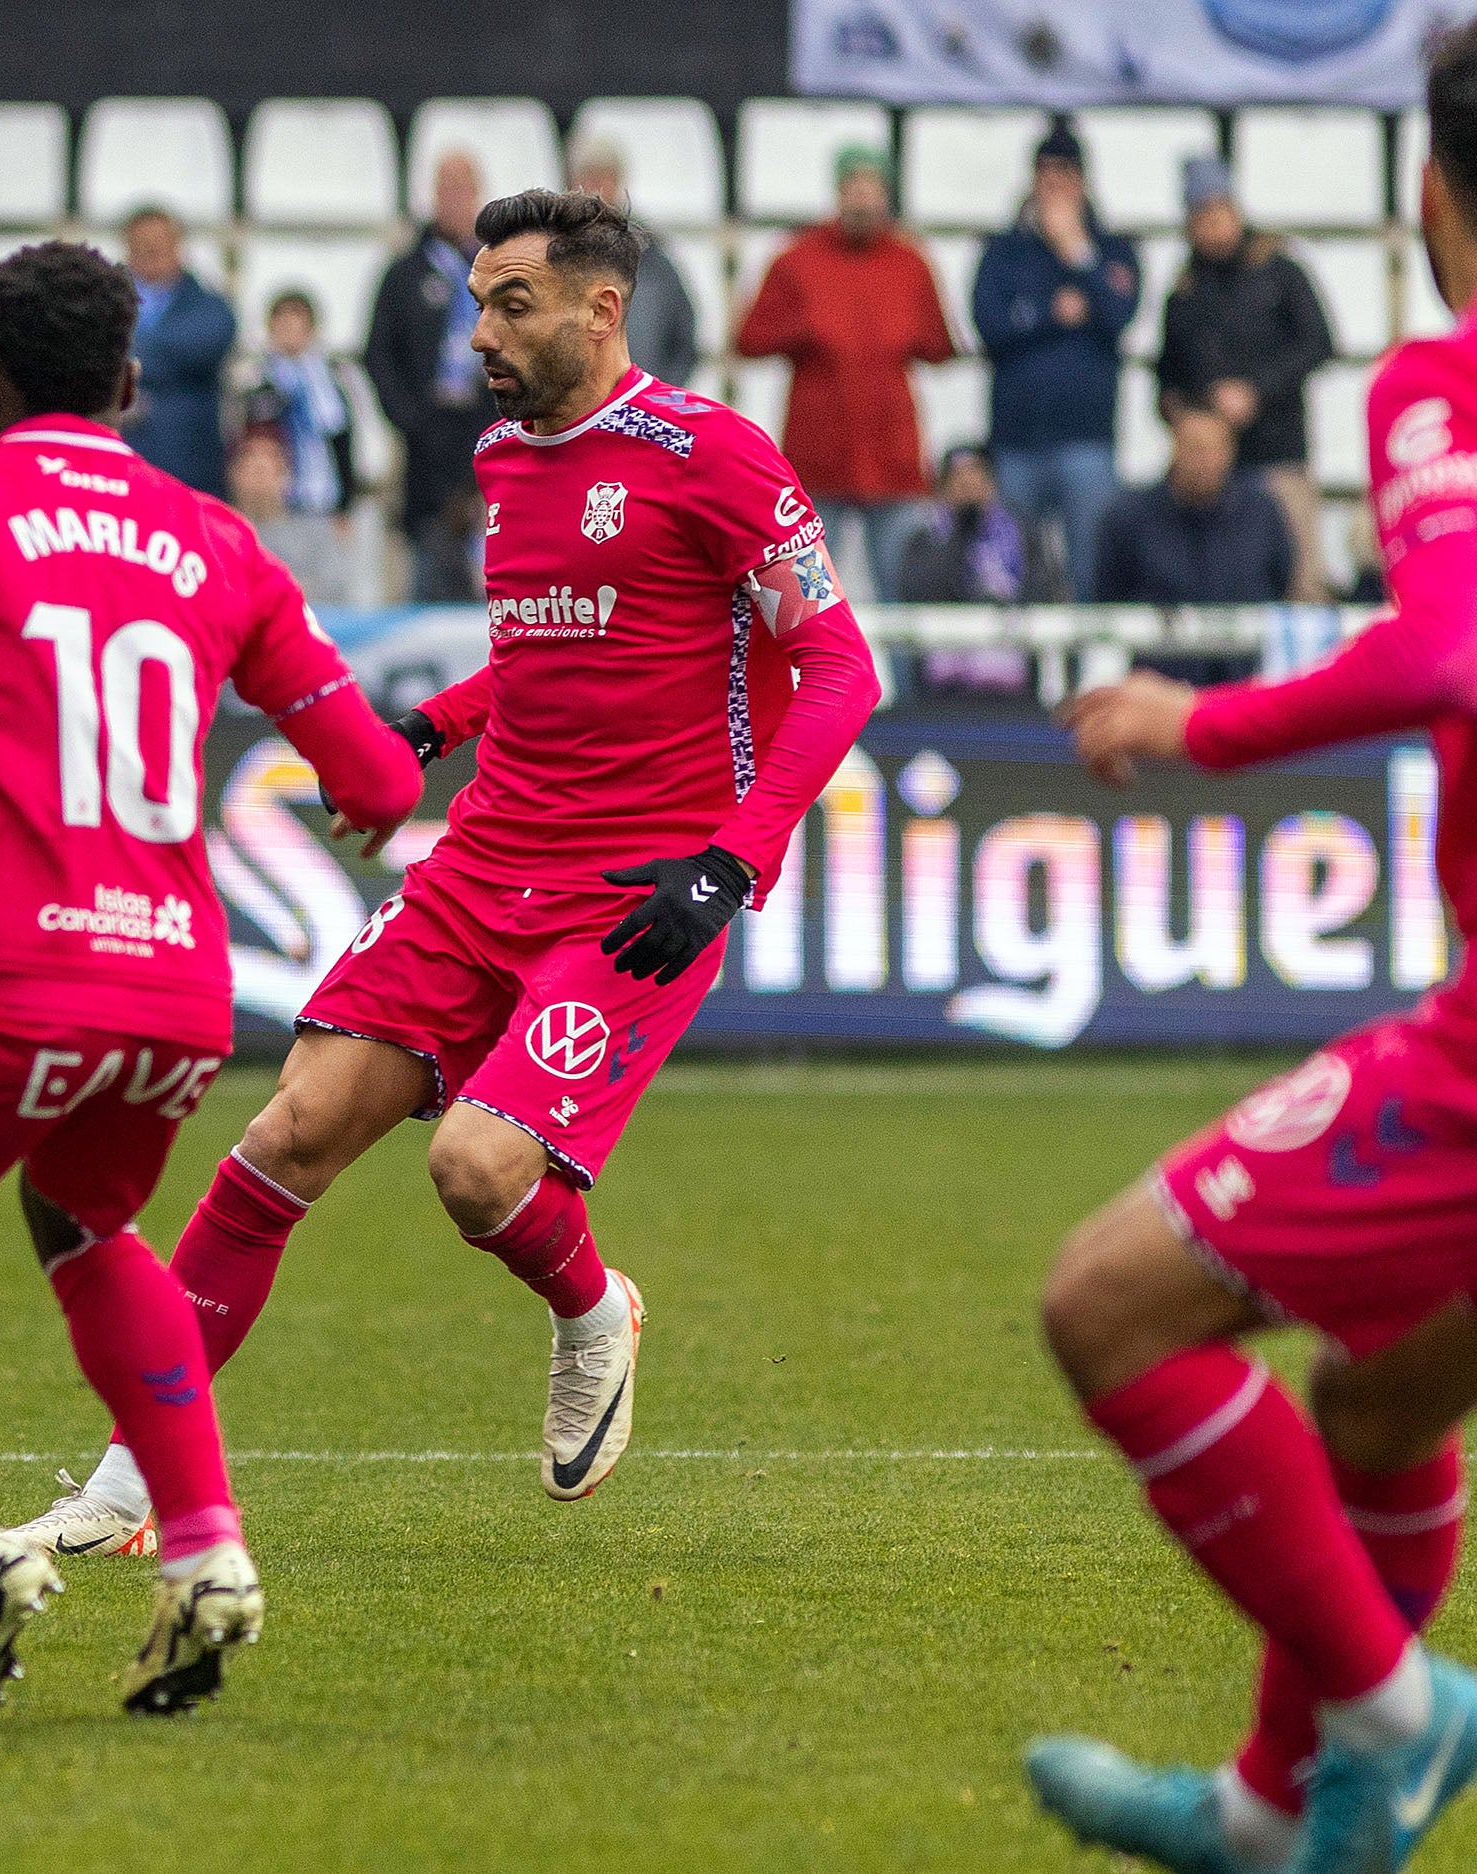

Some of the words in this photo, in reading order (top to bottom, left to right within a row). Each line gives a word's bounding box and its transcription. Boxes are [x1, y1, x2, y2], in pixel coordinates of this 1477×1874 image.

[7, 506, 207, 598] MARLOS
[488, 585, 617, 636] enerife!
[525, 626, 595, 638] emociones
[21, 601, 199, 844] 10
[94, 883, 152, 918] Islas
[37, 903, 153, 941] Canarias
[184, 1290, 230, 1316] RIFE
